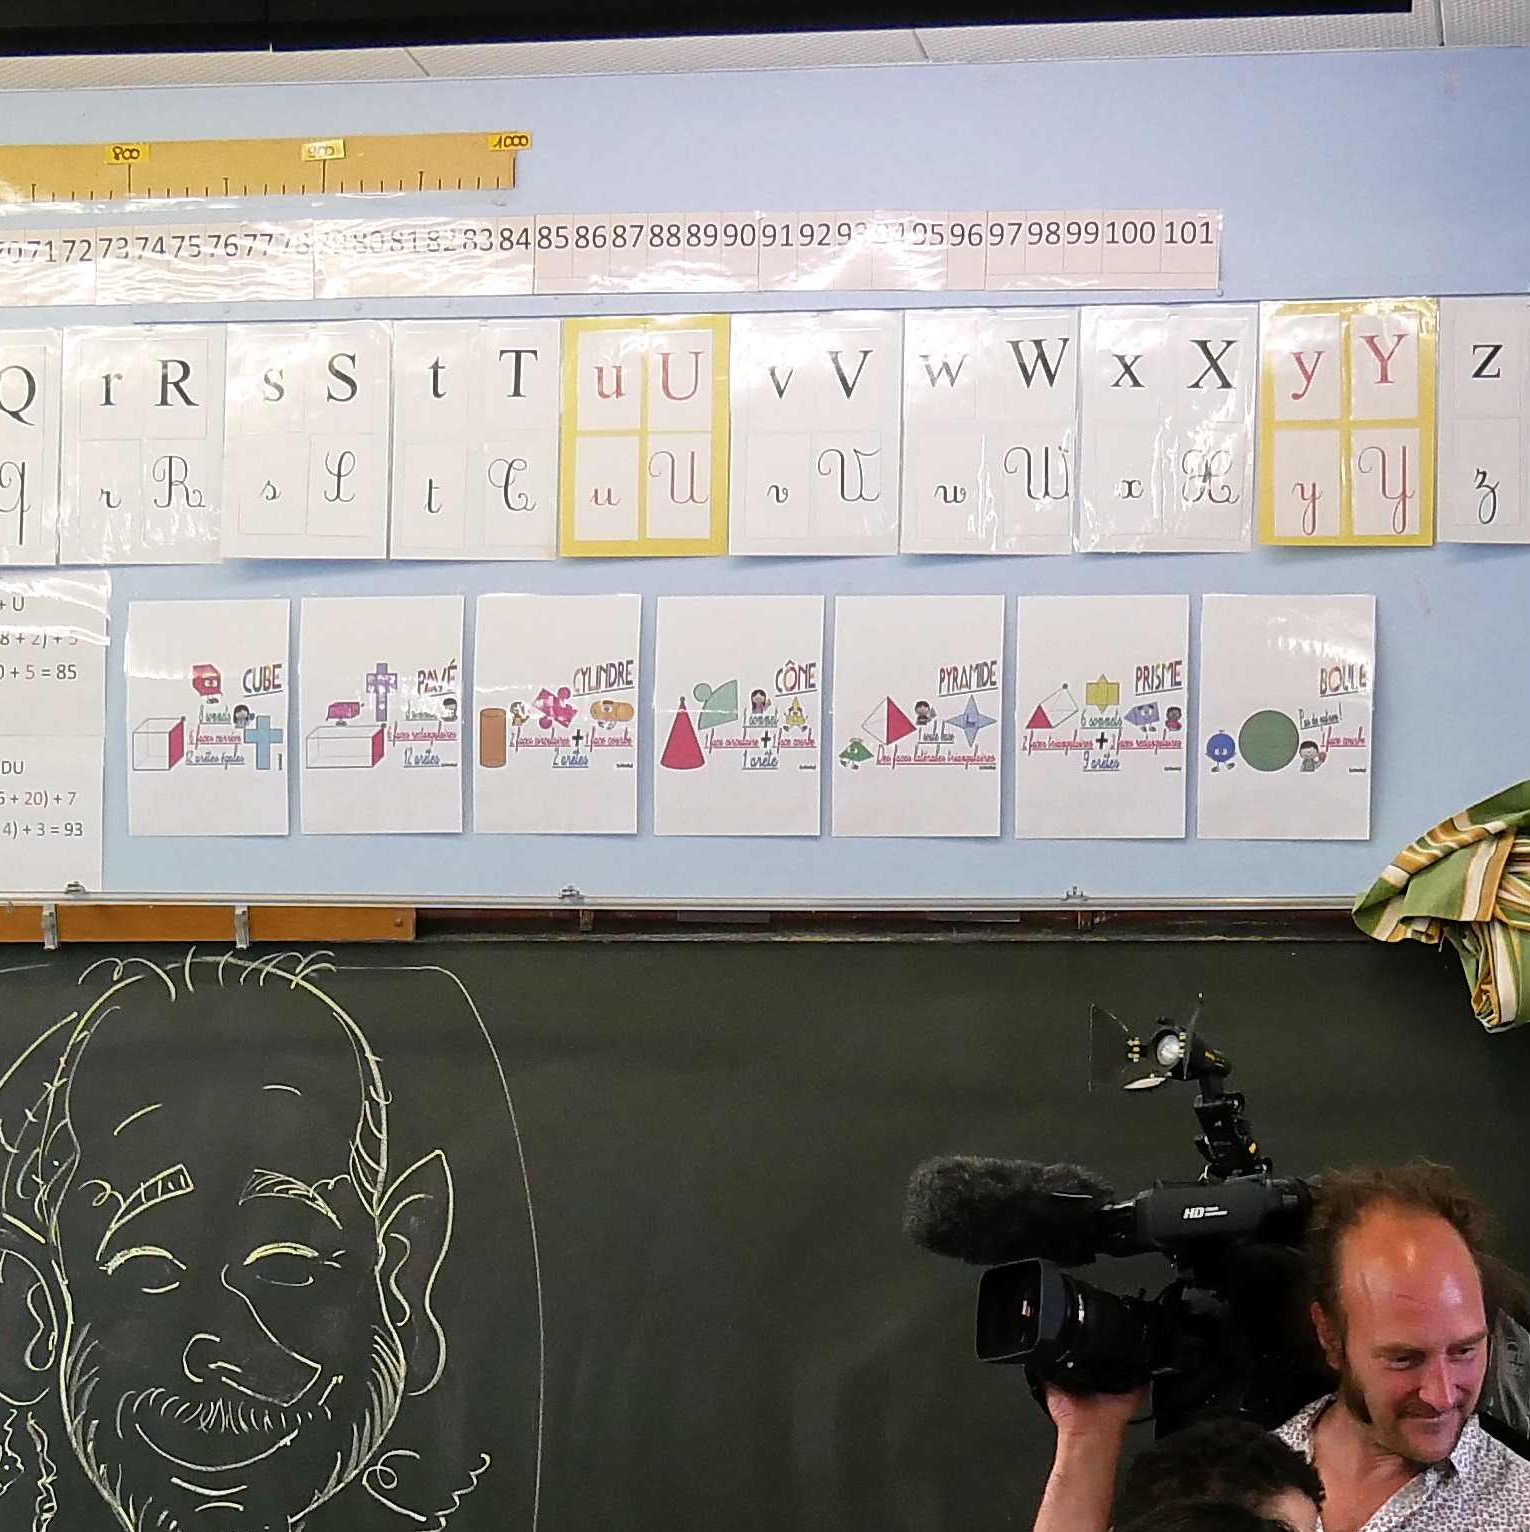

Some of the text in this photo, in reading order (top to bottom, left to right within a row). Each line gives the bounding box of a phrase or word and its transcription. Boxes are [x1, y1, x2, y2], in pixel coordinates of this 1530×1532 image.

[113, 146, 140, 160] 800
[493, 135, 528, 148] 1000
[537, 223, 569, 251] 85
[1066, 221, 1099, 247] 99
[1104, 221, 1156, 247] 100
[1165, 221, 1214, 246] 101
[12, 596, 25, 612] U
[241, 663, 284, 694] CUBE
[573, 659, 634, 694] CYLINDRE
[775, 659, 817, 693] CÔNE
[939, 660, 998, 695] PYRAMIDE
[1135, 660, 1183, 694] PRISME
[1, 760, 24, 775] DU
[63, 822, 83, 837] 93
[1182, 1206, 1205, 1219] HD
